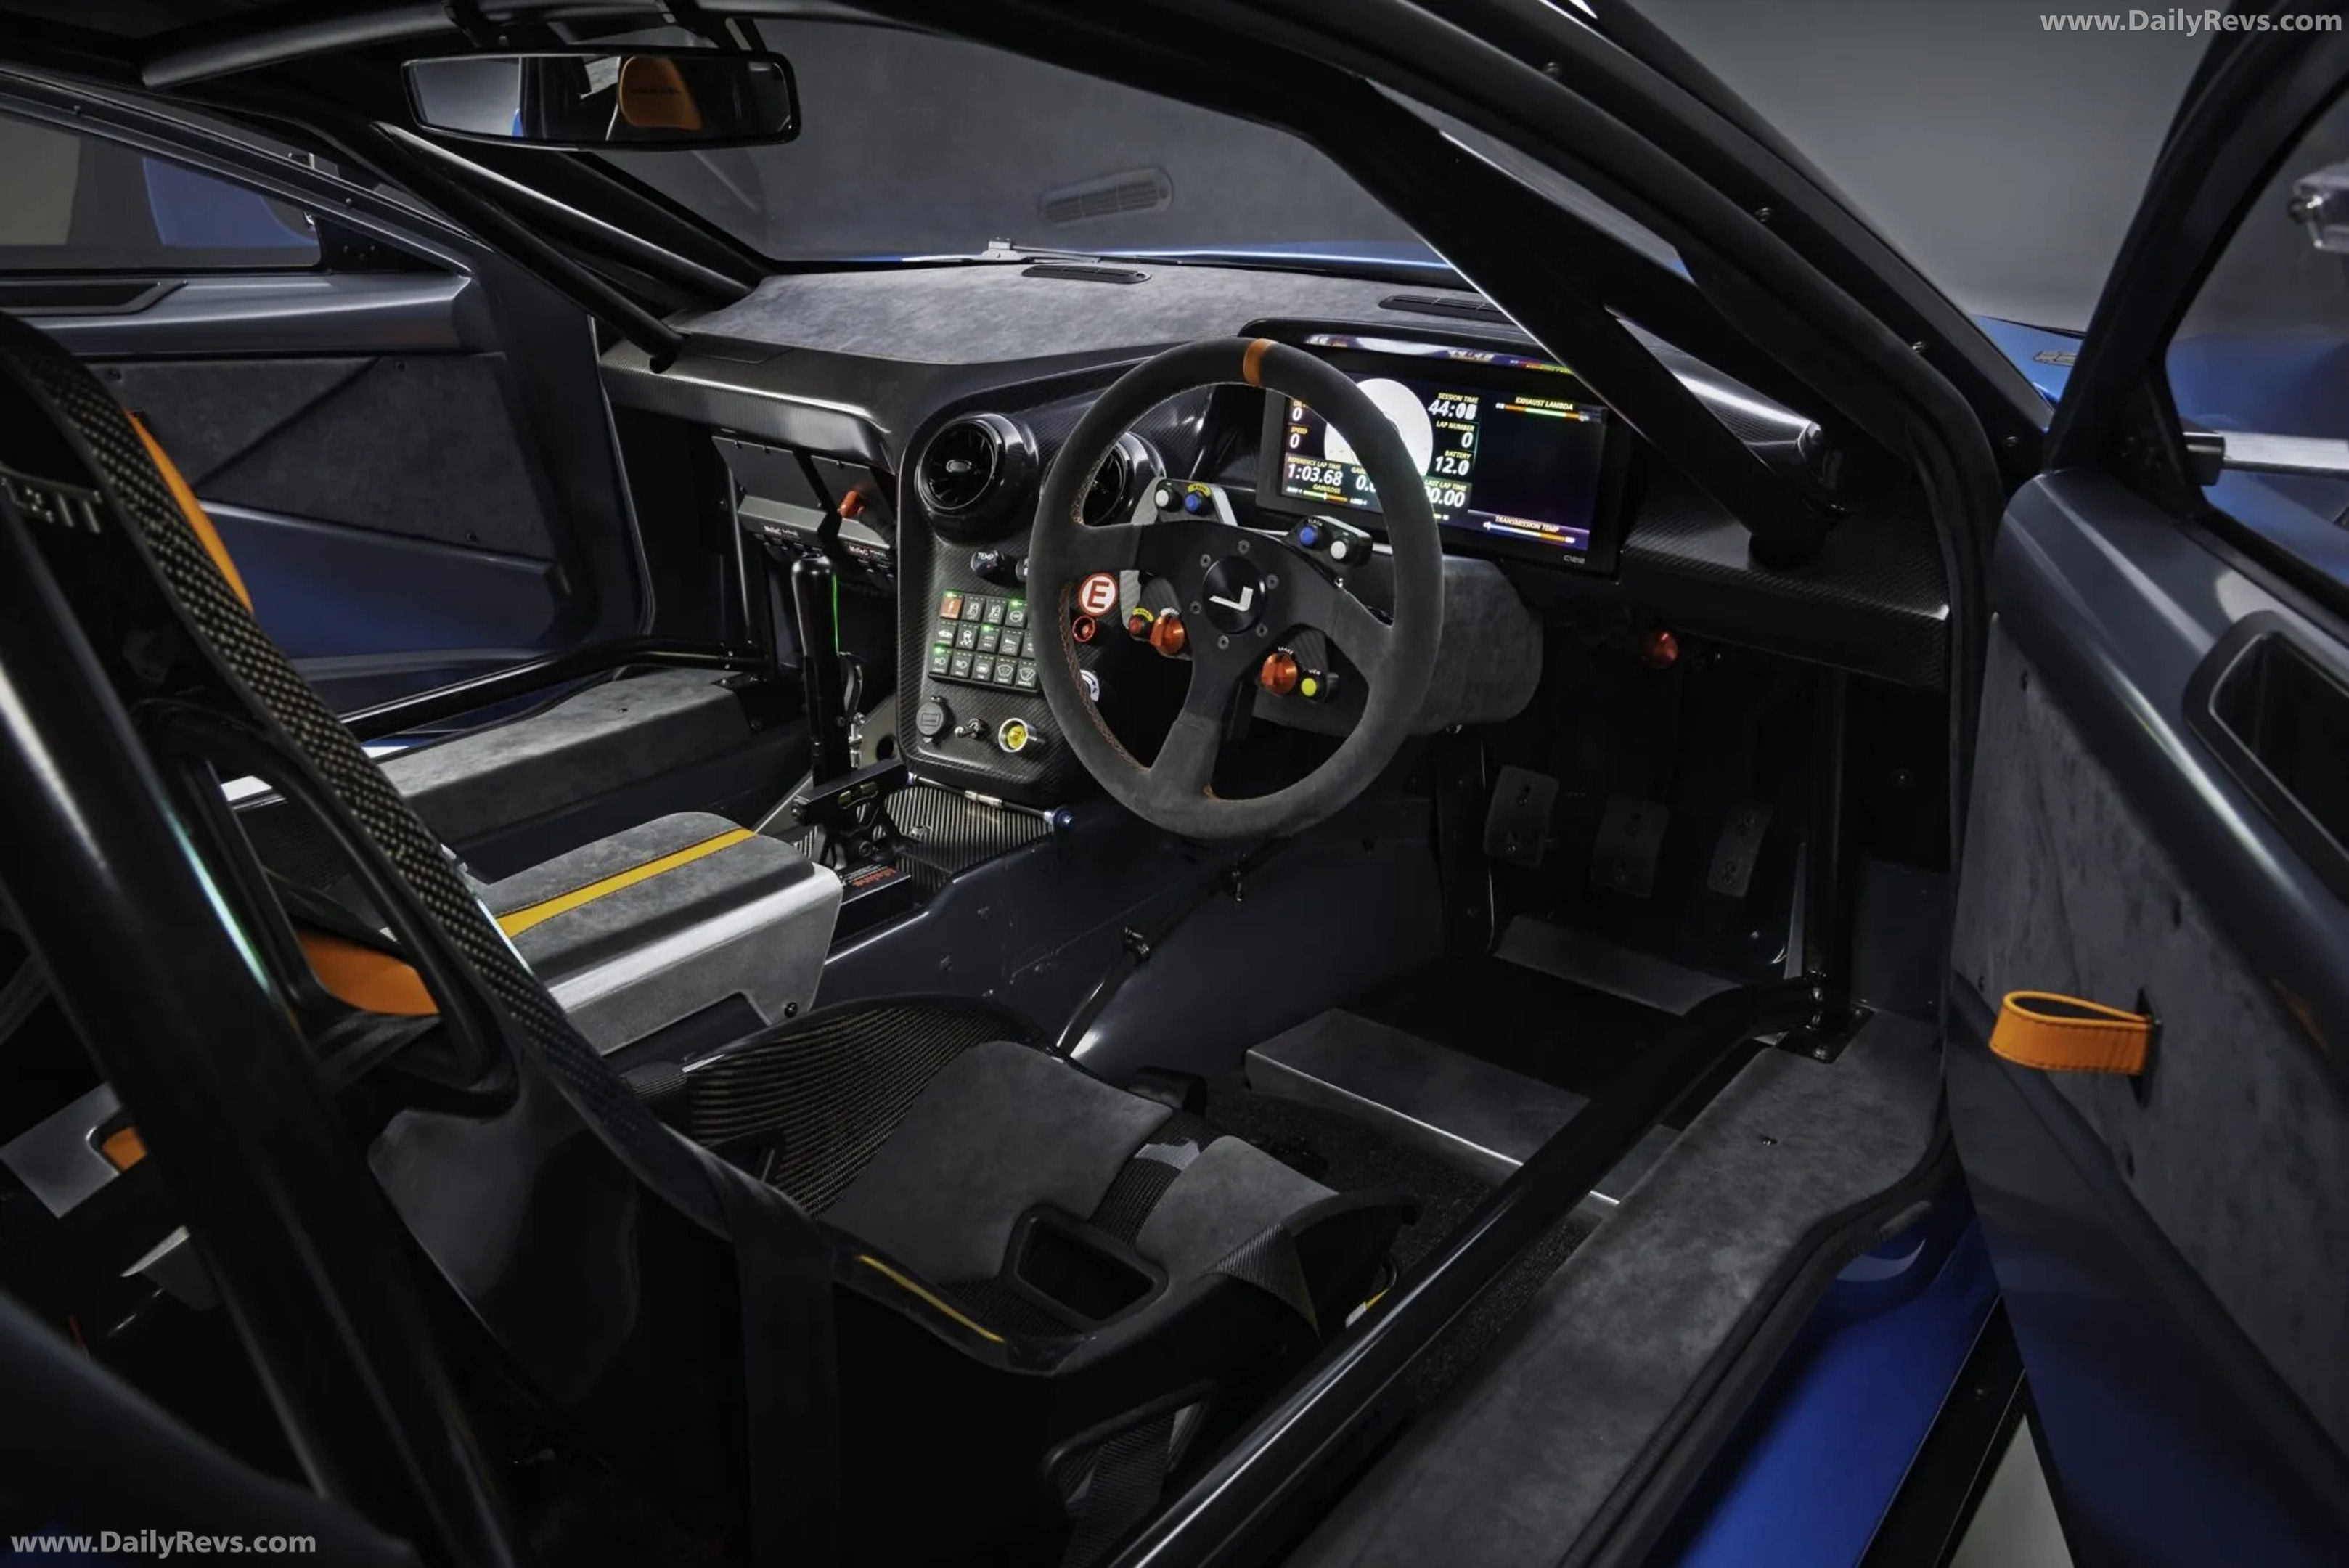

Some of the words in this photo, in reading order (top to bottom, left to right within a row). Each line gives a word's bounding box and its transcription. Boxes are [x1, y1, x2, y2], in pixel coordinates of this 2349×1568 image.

[1438, 393, 1463, 401] SESSION
[1515, 396, 1545, 407] EXHAUST
[1545, 400, 1574, 410] LAMBDA
[1292, 407, 1303, 422] 0
[1291, 426, 1308, 435] SPEED
[1448, 422, 1475, 432] NUMBER
[1289, 433, 1300, 449] 0
[1461, 431, 1474, 449] 0
[1288, 457, 1316, 467] REFERENCE
[1445, 450, 1472, 460] BATTERY
[1435, 456, 1470, 475] 12.0
[1288, 463, 1343, 486] 1:03.68
[1452, 483, 1468, 491] TIME
[1495, 515, 1541, 531] TRANSMISSION
[1541, 523, 1560, 533] TEMP
[1087, 580, 1110, 609] E
